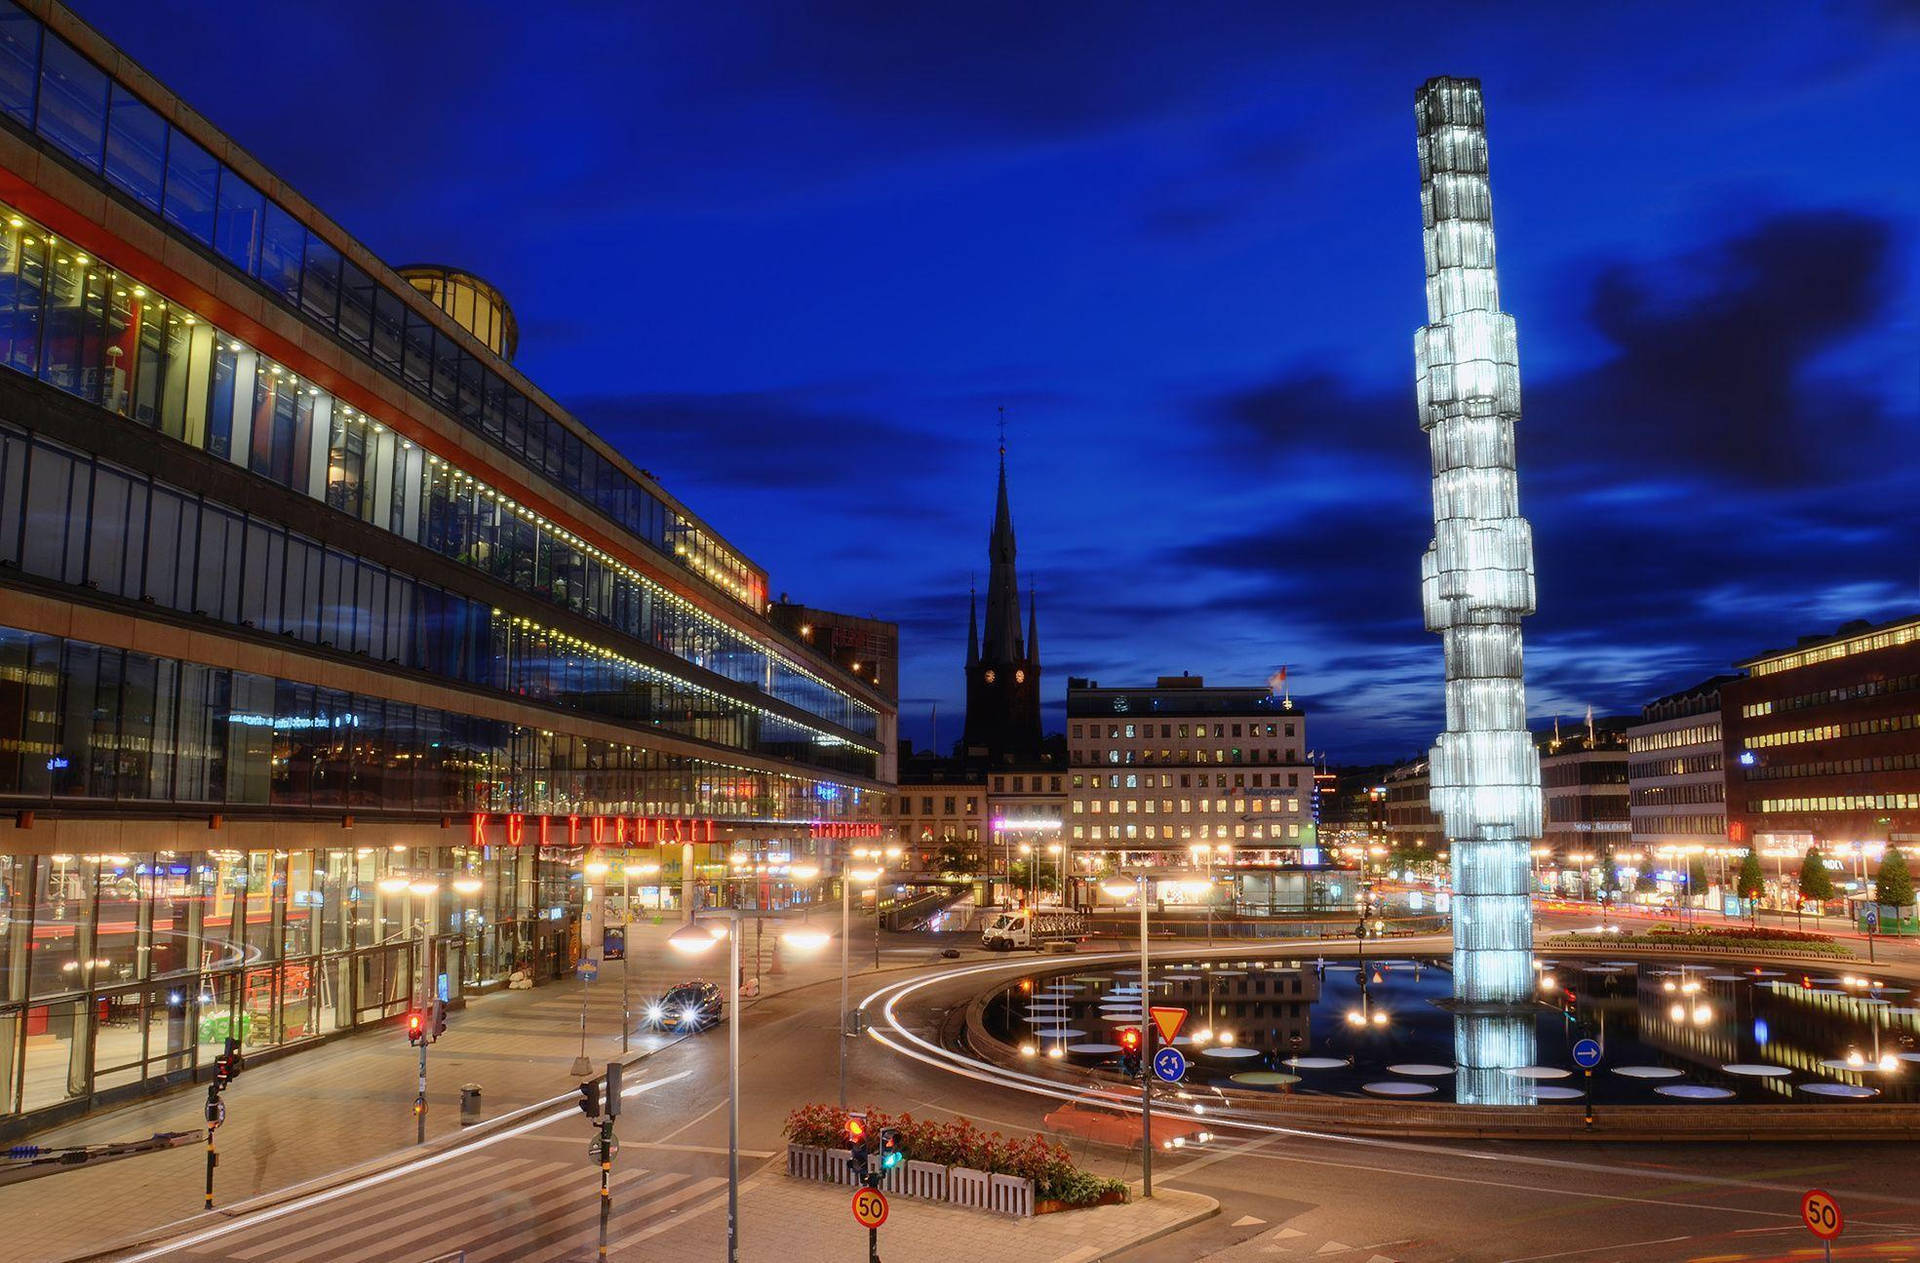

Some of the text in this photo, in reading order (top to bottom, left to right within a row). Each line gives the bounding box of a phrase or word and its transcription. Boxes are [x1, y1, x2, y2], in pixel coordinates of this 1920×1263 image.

[473, 812, 714, 846] KULTURHUSET
[859, 1197, 883, 1218] 50
[1809, 1200, 1836, 1229] 50
